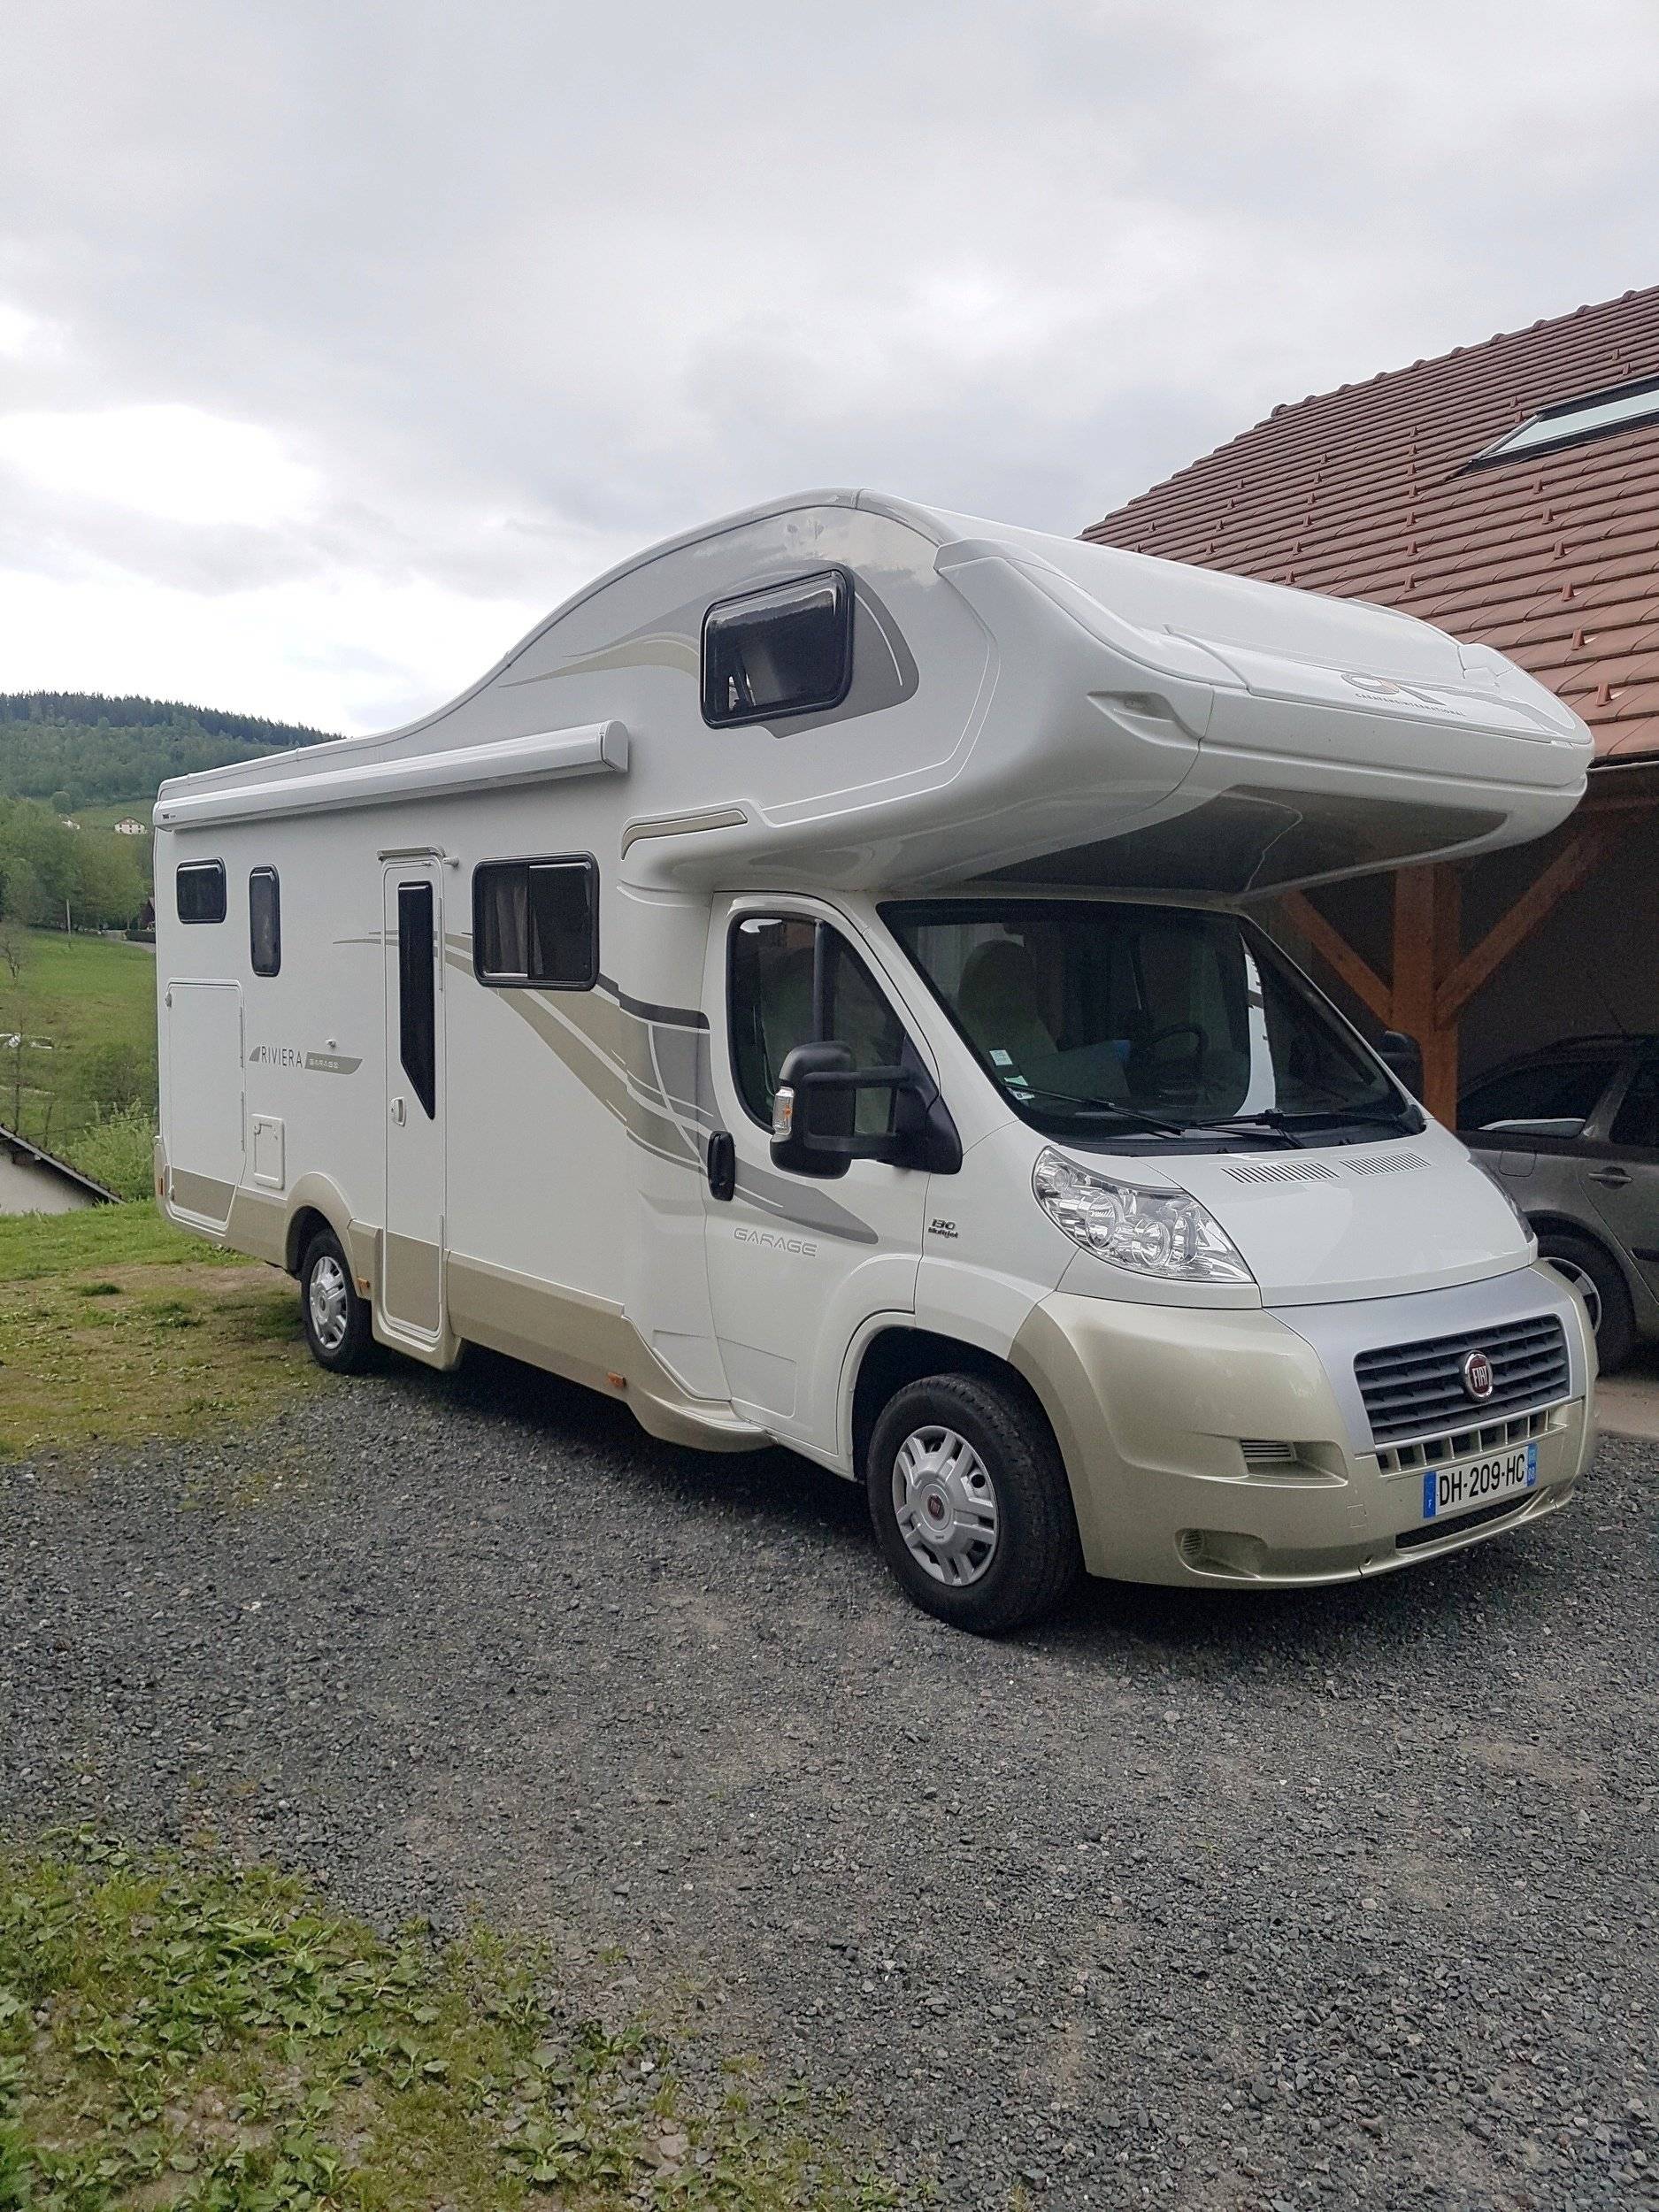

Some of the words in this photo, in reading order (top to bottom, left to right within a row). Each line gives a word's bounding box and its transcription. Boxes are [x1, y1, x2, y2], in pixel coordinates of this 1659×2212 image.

[261, 1046, 303, 1068] RIVIERA
[733, 1226, 818, 1257] GARAGE
[1471, 1365, 1488, 1388] FIAT
[1439, 1454, 1525, 1507] DH-209-HC
